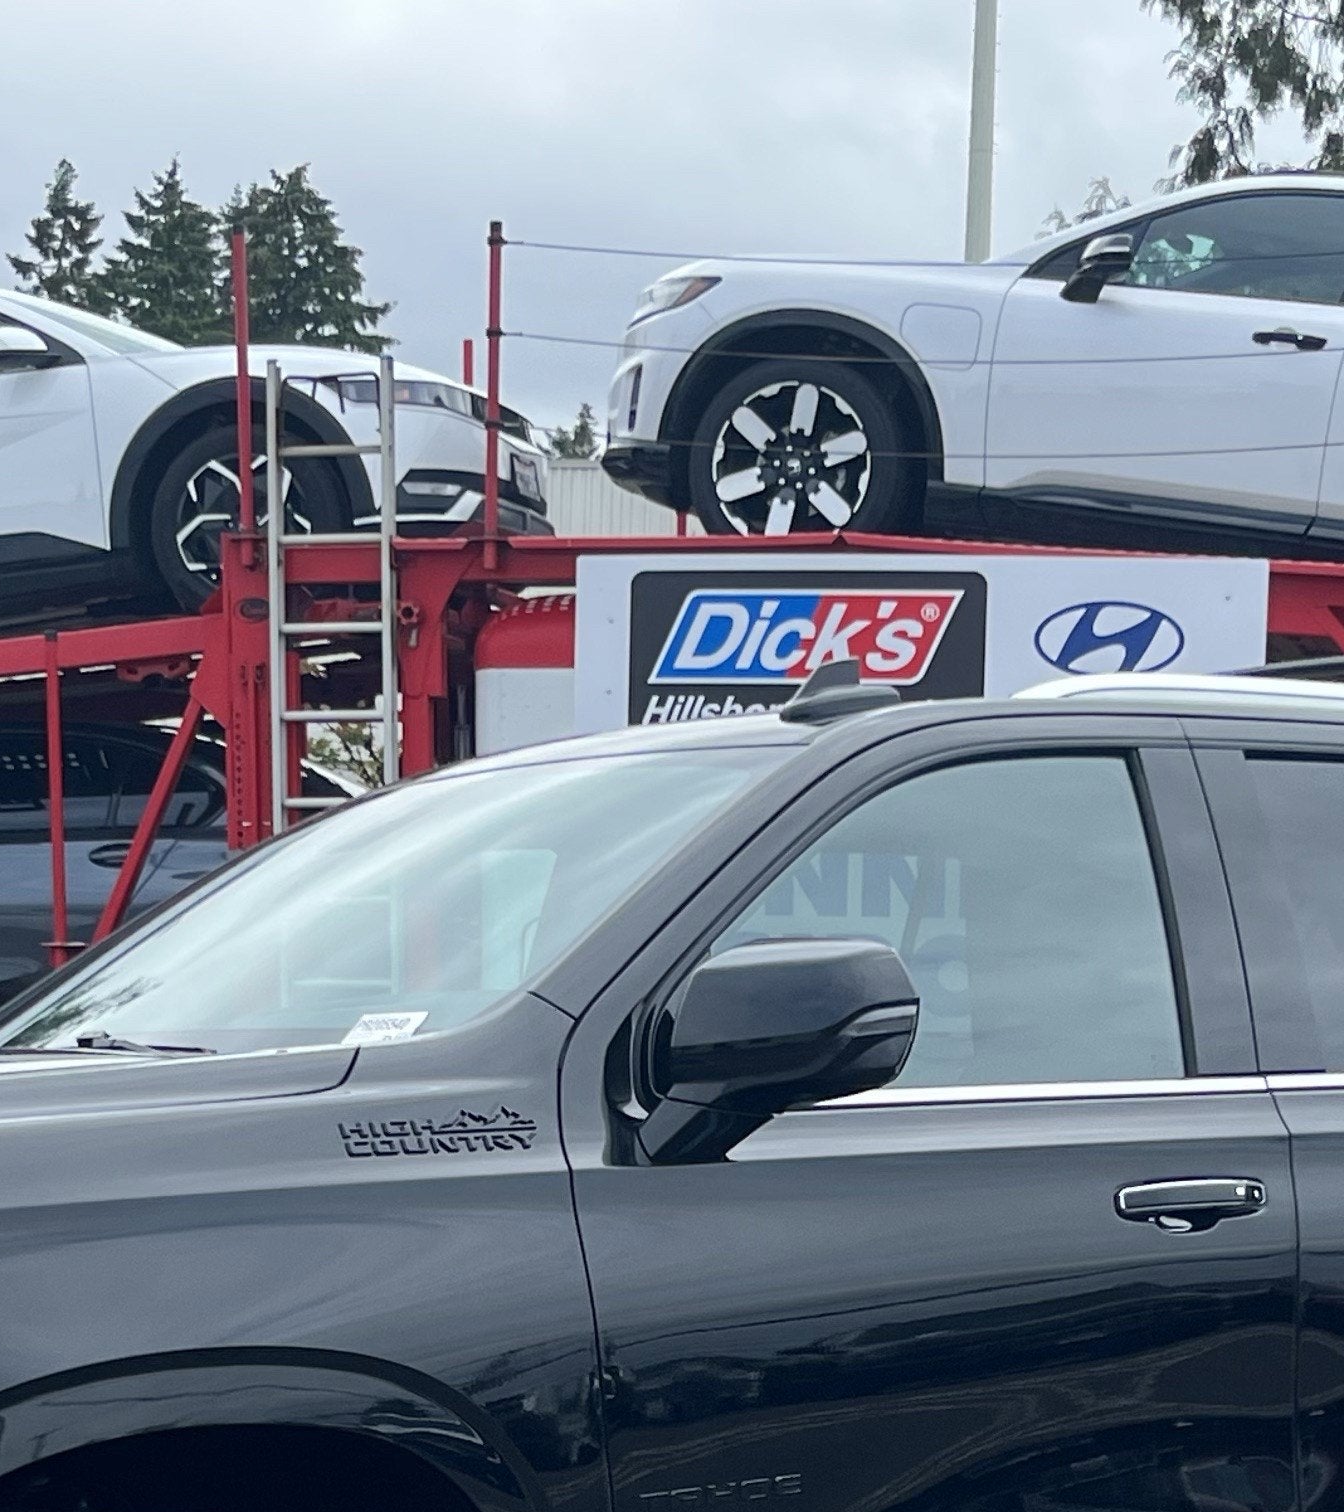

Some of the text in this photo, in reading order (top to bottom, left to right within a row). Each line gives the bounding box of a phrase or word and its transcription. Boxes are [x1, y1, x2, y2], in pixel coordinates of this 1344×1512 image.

[672, 600, 924, 673] Dick's
[338, 1118, 435, 1140] HIGH
[344, 1131, 538, 1158] COUNTRY
